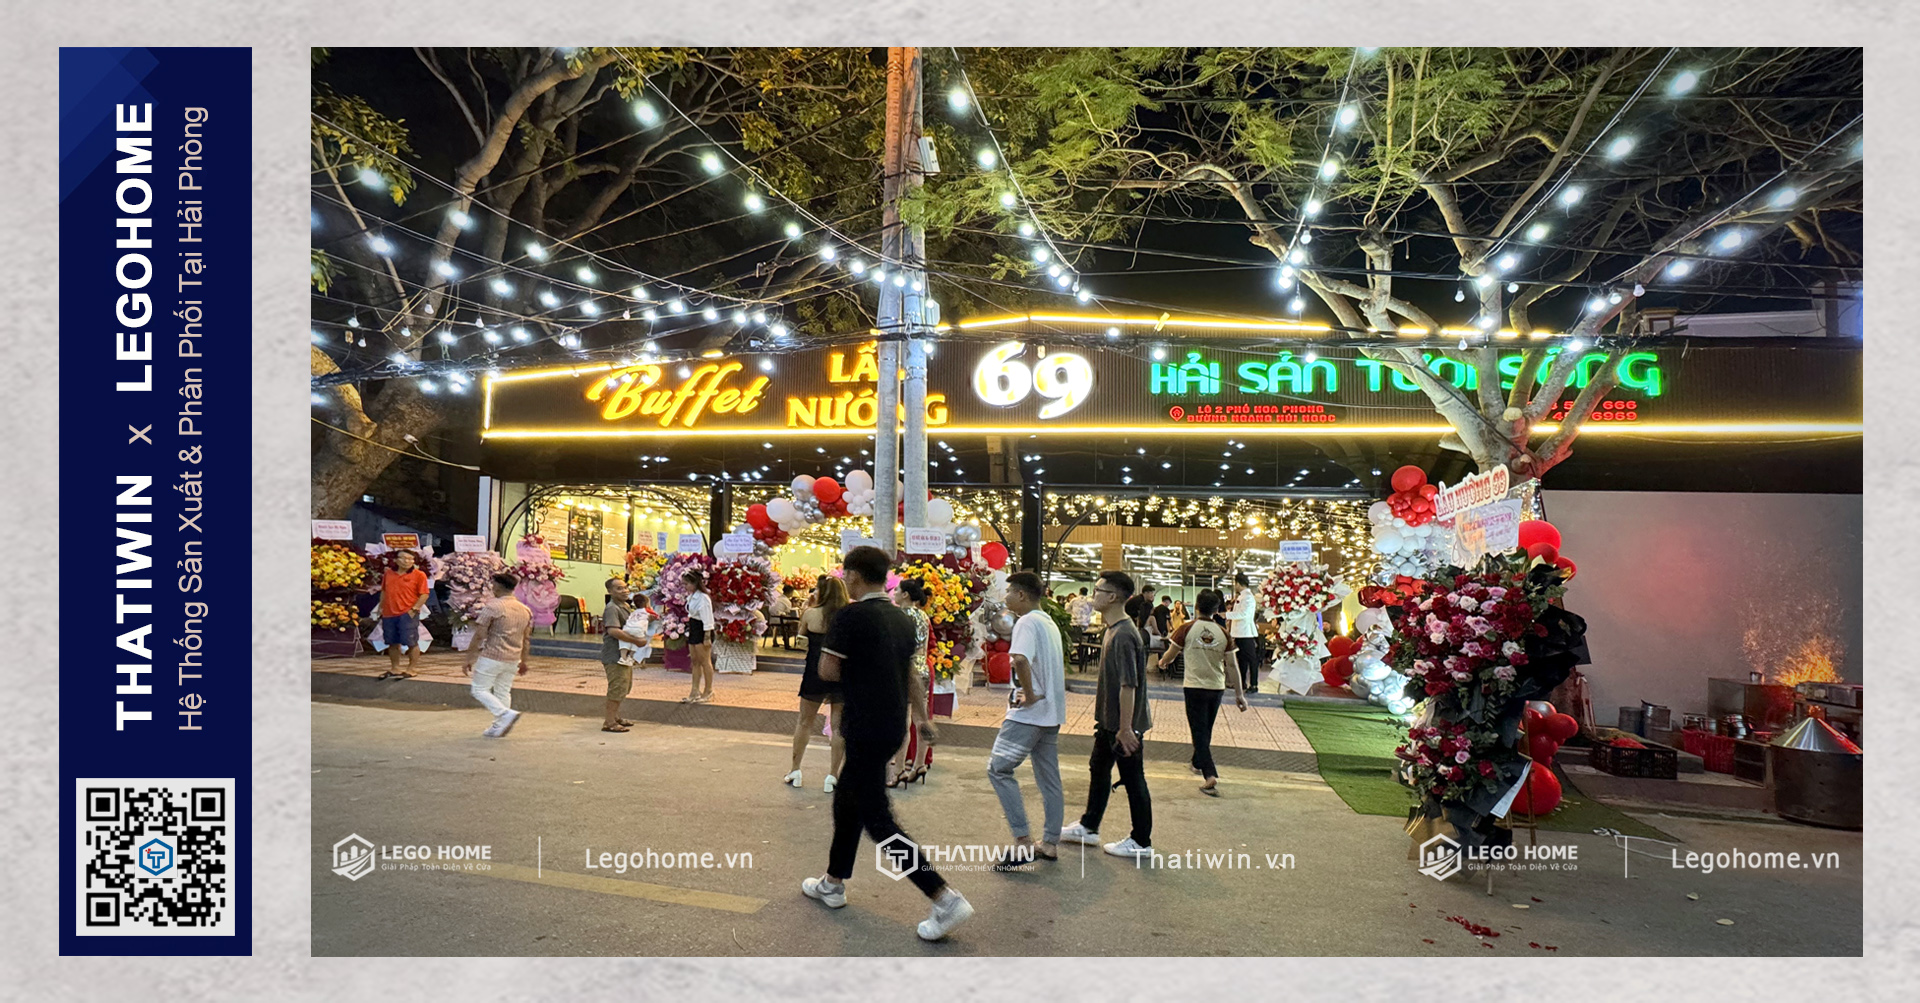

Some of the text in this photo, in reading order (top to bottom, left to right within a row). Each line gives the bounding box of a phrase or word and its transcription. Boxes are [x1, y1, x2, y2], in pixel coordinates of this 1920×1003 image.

[973, 340, 1093, 420] 69
[1150, 351, 1222, 396] HẢI
[1237, 350, 1338, 395] SẢN
[585, 362, 771, 428] Buffet
[786, 387, 949, 427] NƯỚG
[1214, 405, 1223, 413] 2
[1602, 400, 1638, 411] 666
[1591, 411, 1638, 422] 6969
